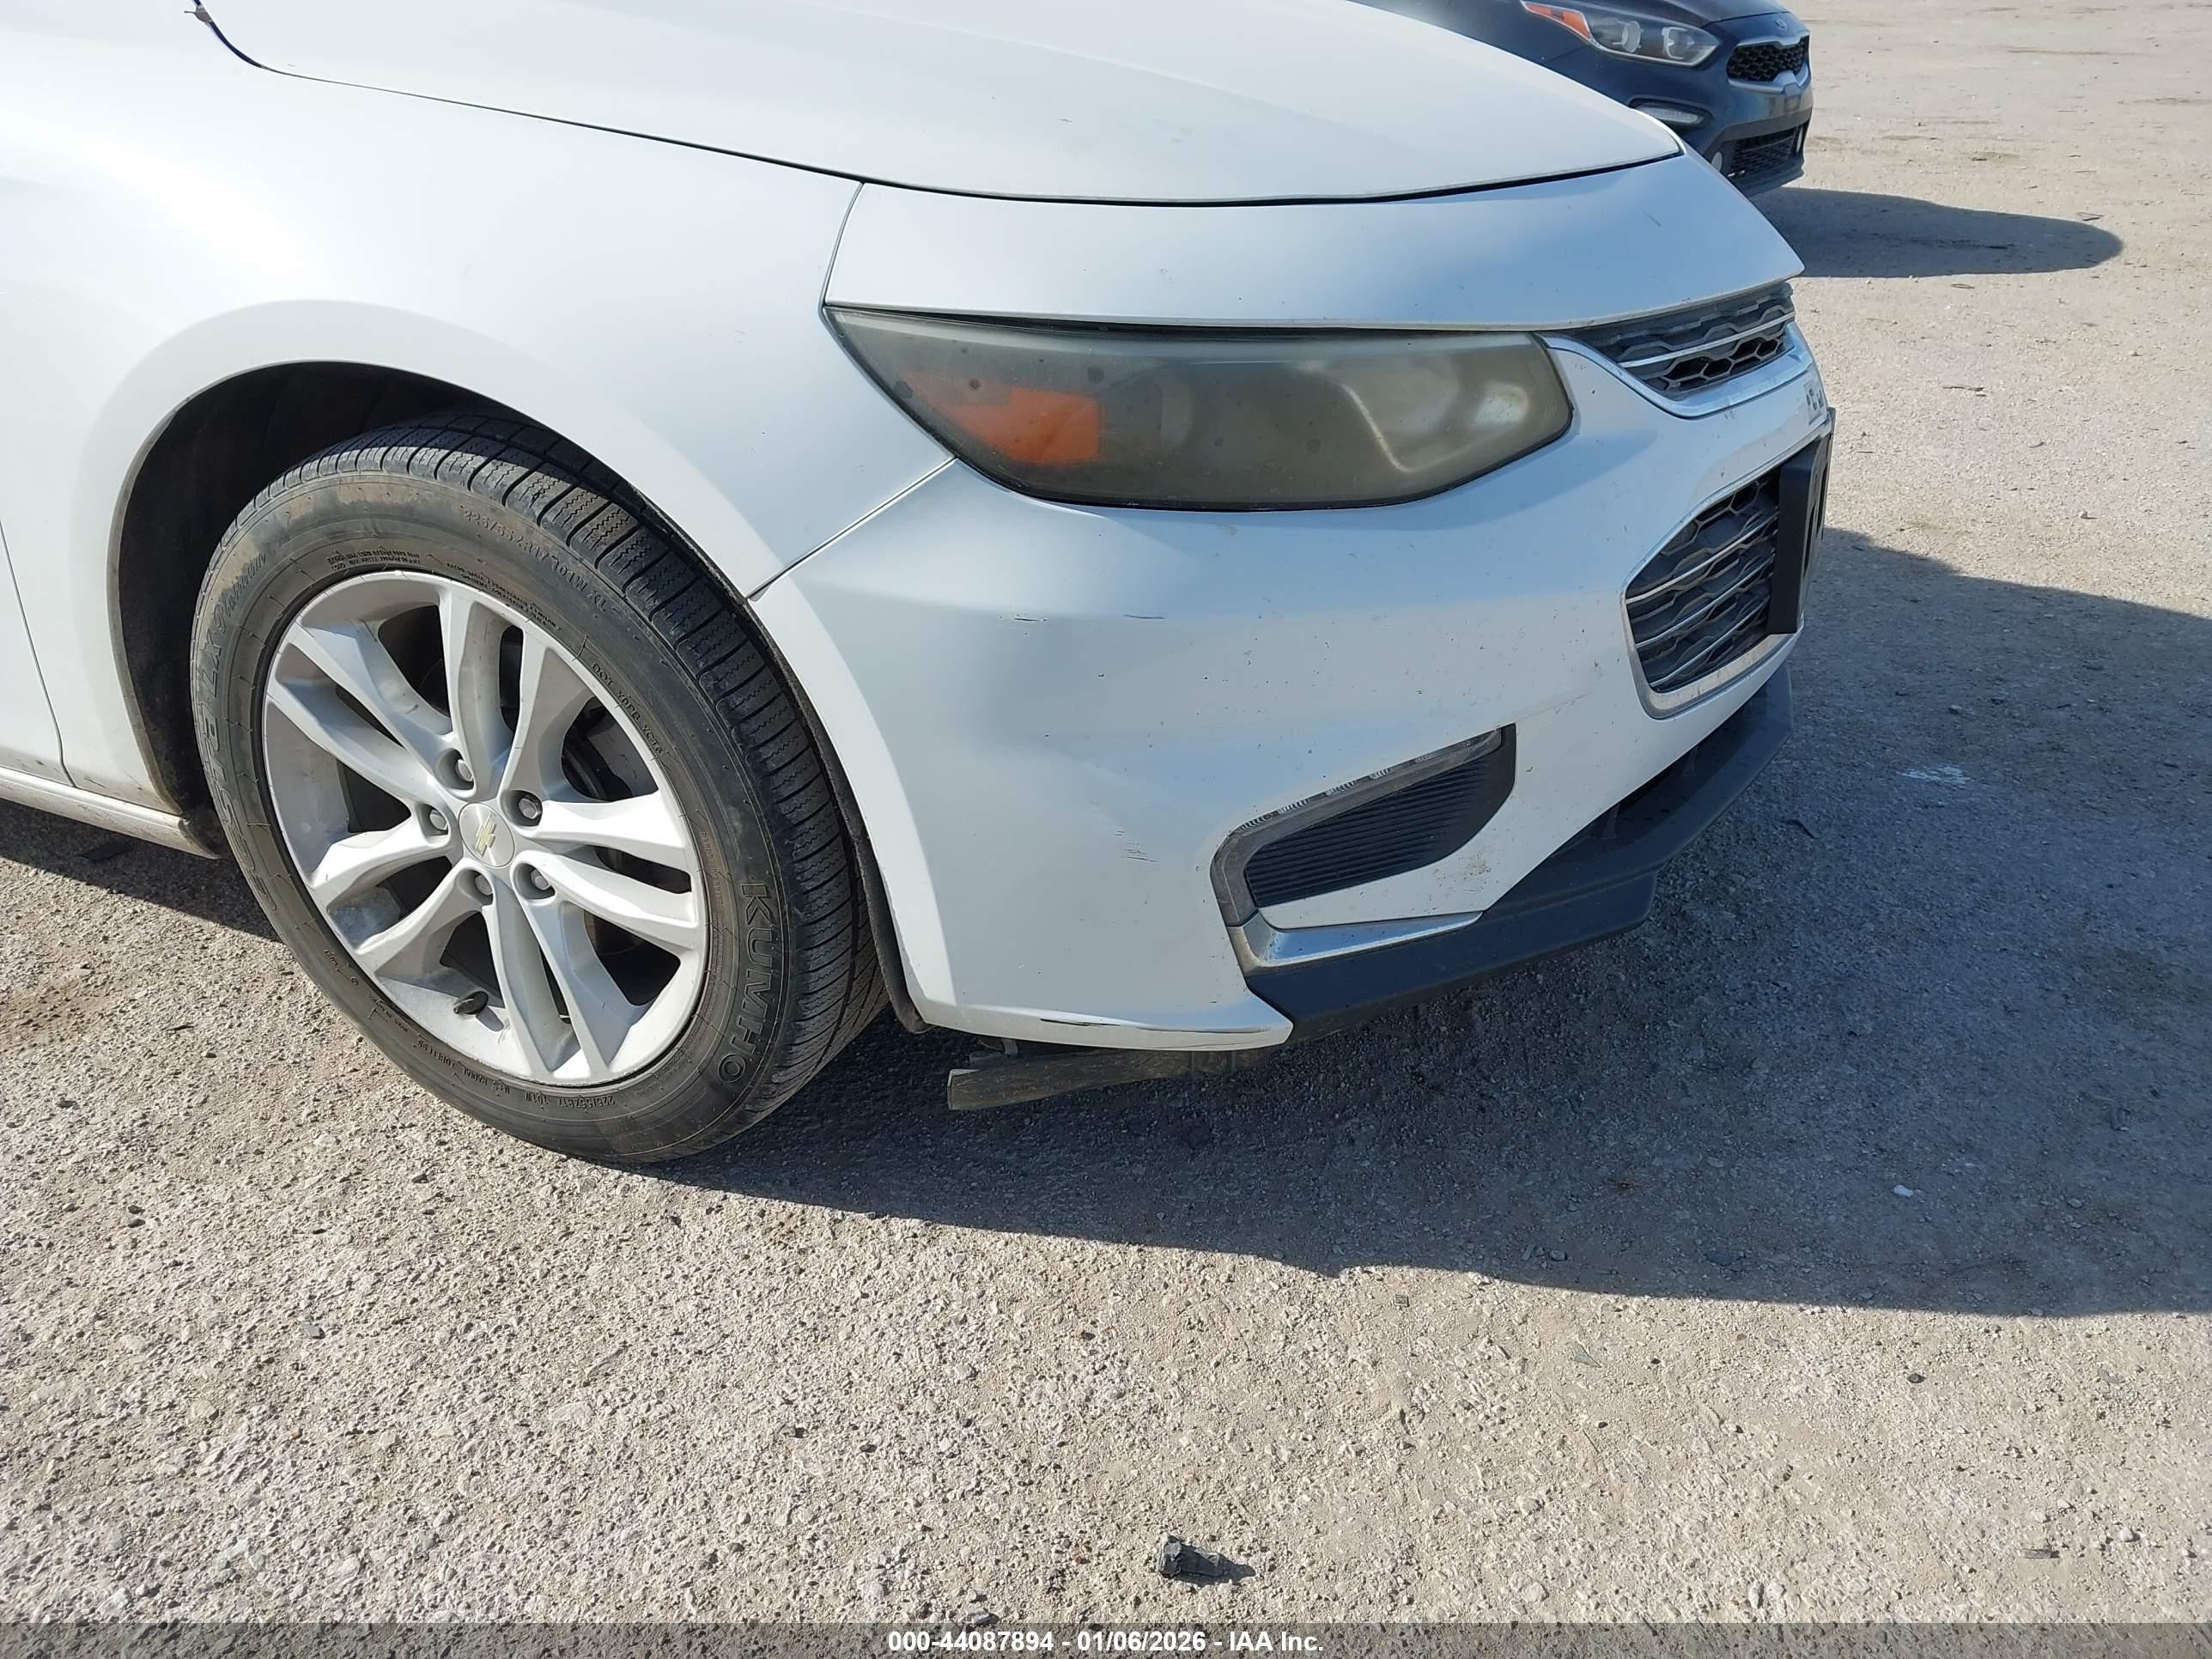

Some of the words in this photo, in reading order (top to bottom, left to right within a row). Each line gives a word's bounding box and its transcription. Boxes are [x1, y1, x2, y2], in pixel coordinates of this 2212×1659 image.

[199, 632, 222, 698] LX
[212, 552, 267, 632] Platinum
[592, 662, 614, 686] DOT
[719, 882, 774, 1083] KUMHO
